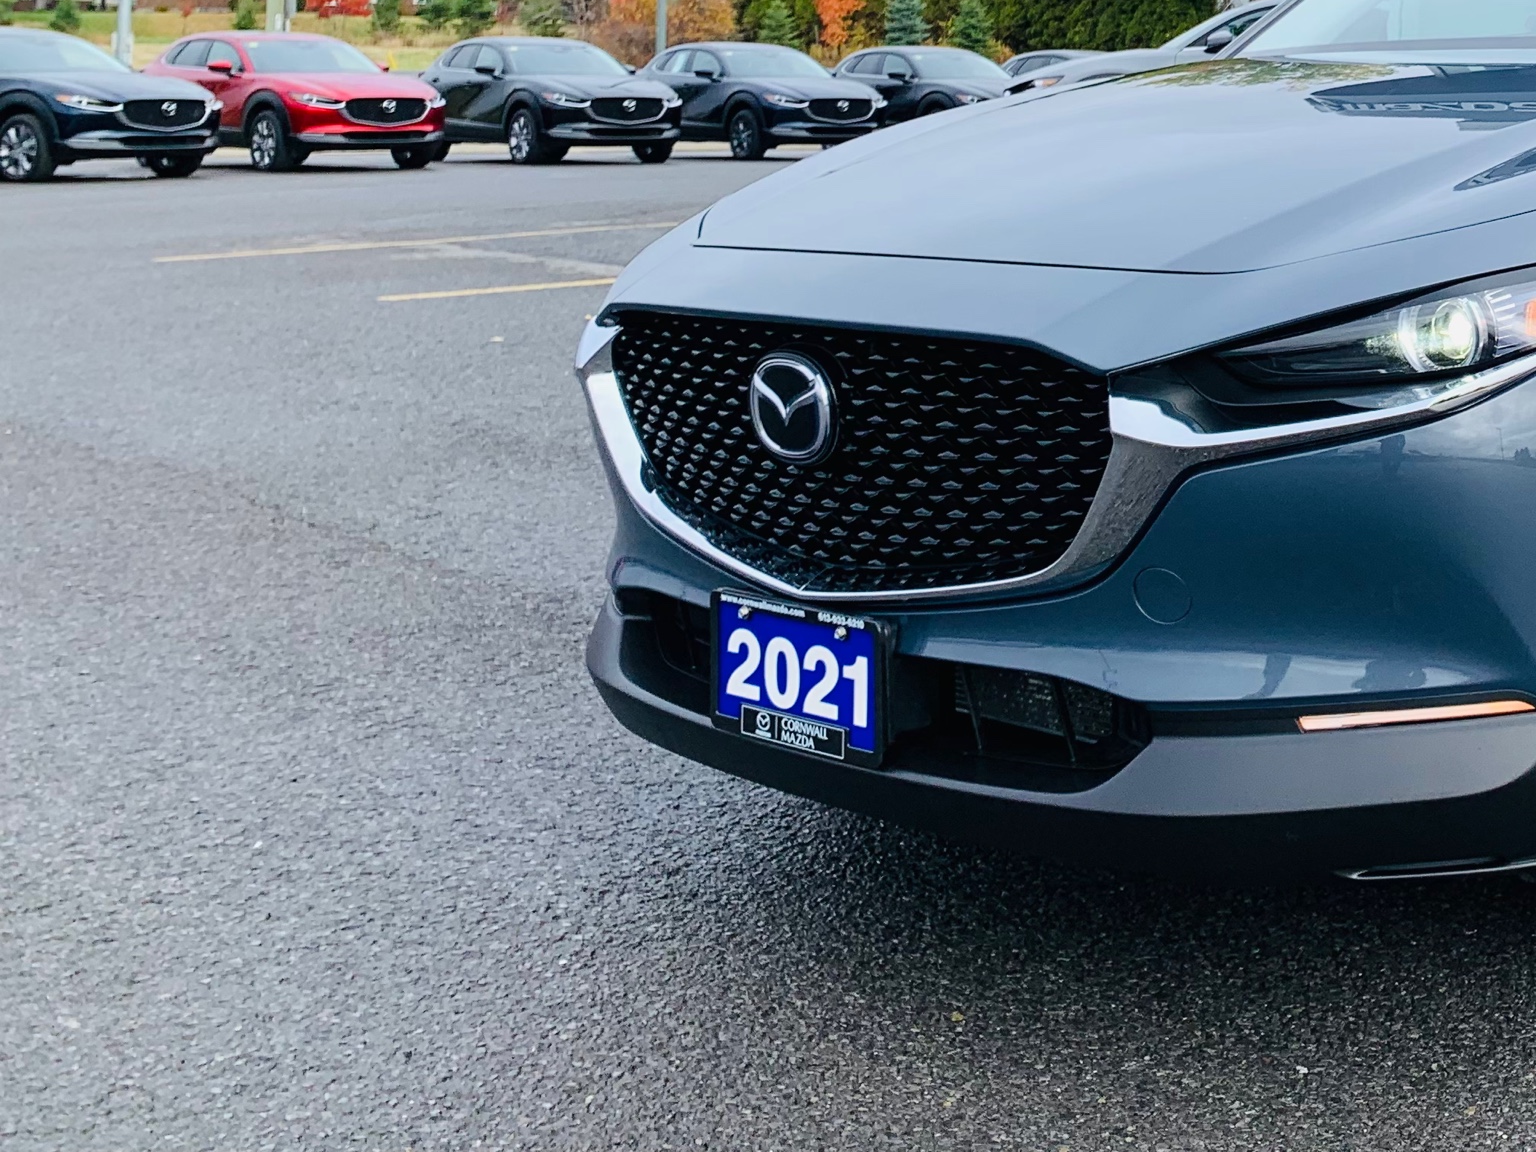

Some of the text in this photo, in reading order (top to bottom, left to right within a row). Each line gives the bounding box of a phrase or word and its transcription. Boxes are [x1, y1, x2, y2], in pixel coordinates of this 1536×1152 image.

[725, 627, 868, 729] 2021
[781, 718, 829, 740] CORNWALL
[781, 730, 815, 750] MAZDA
